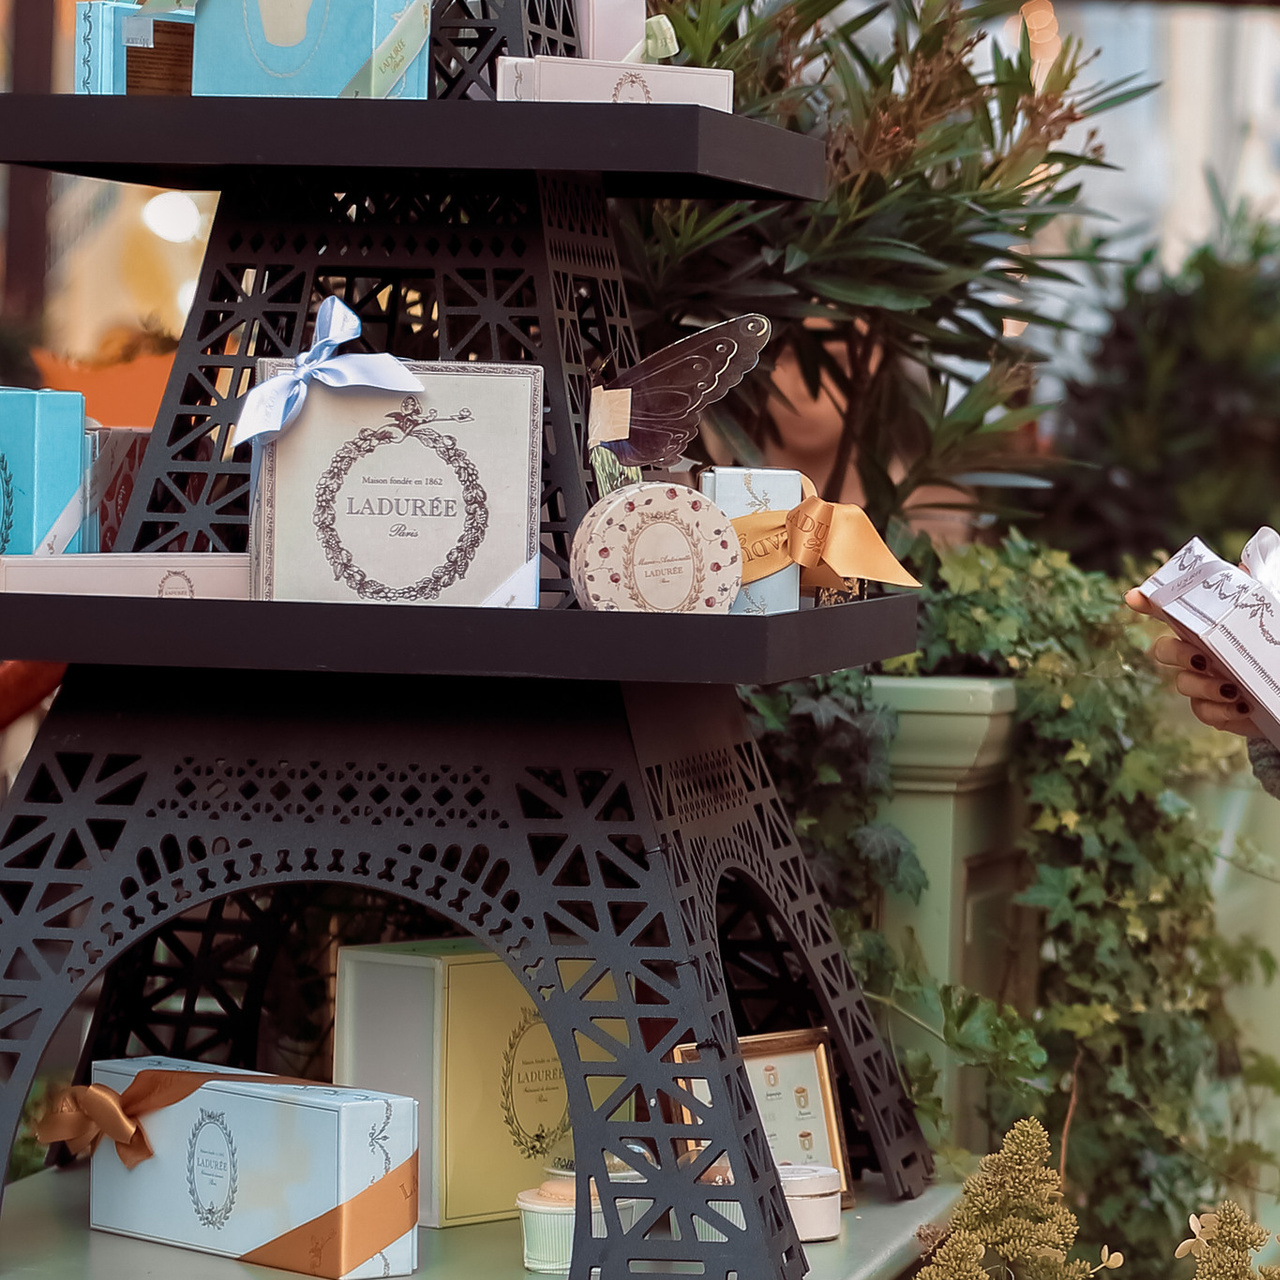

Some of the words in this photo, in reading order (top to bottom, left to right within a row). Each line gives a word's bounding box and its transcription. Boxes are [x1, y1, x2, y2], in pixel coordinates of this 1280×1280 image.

[362, 476, 388, 485] Maison
[390, 476, 412, 485] fondée
[425, 477, 443, 486] 1862
[346, 496, 458, 517] LADURÉE
[388, 523, 419, 538] Paris
[644, 566, 684, 578] LADURÉE
[517, 1067, 564, 1084] LADURÉE
[197, 1157, 227, 1171] LADURÉE
